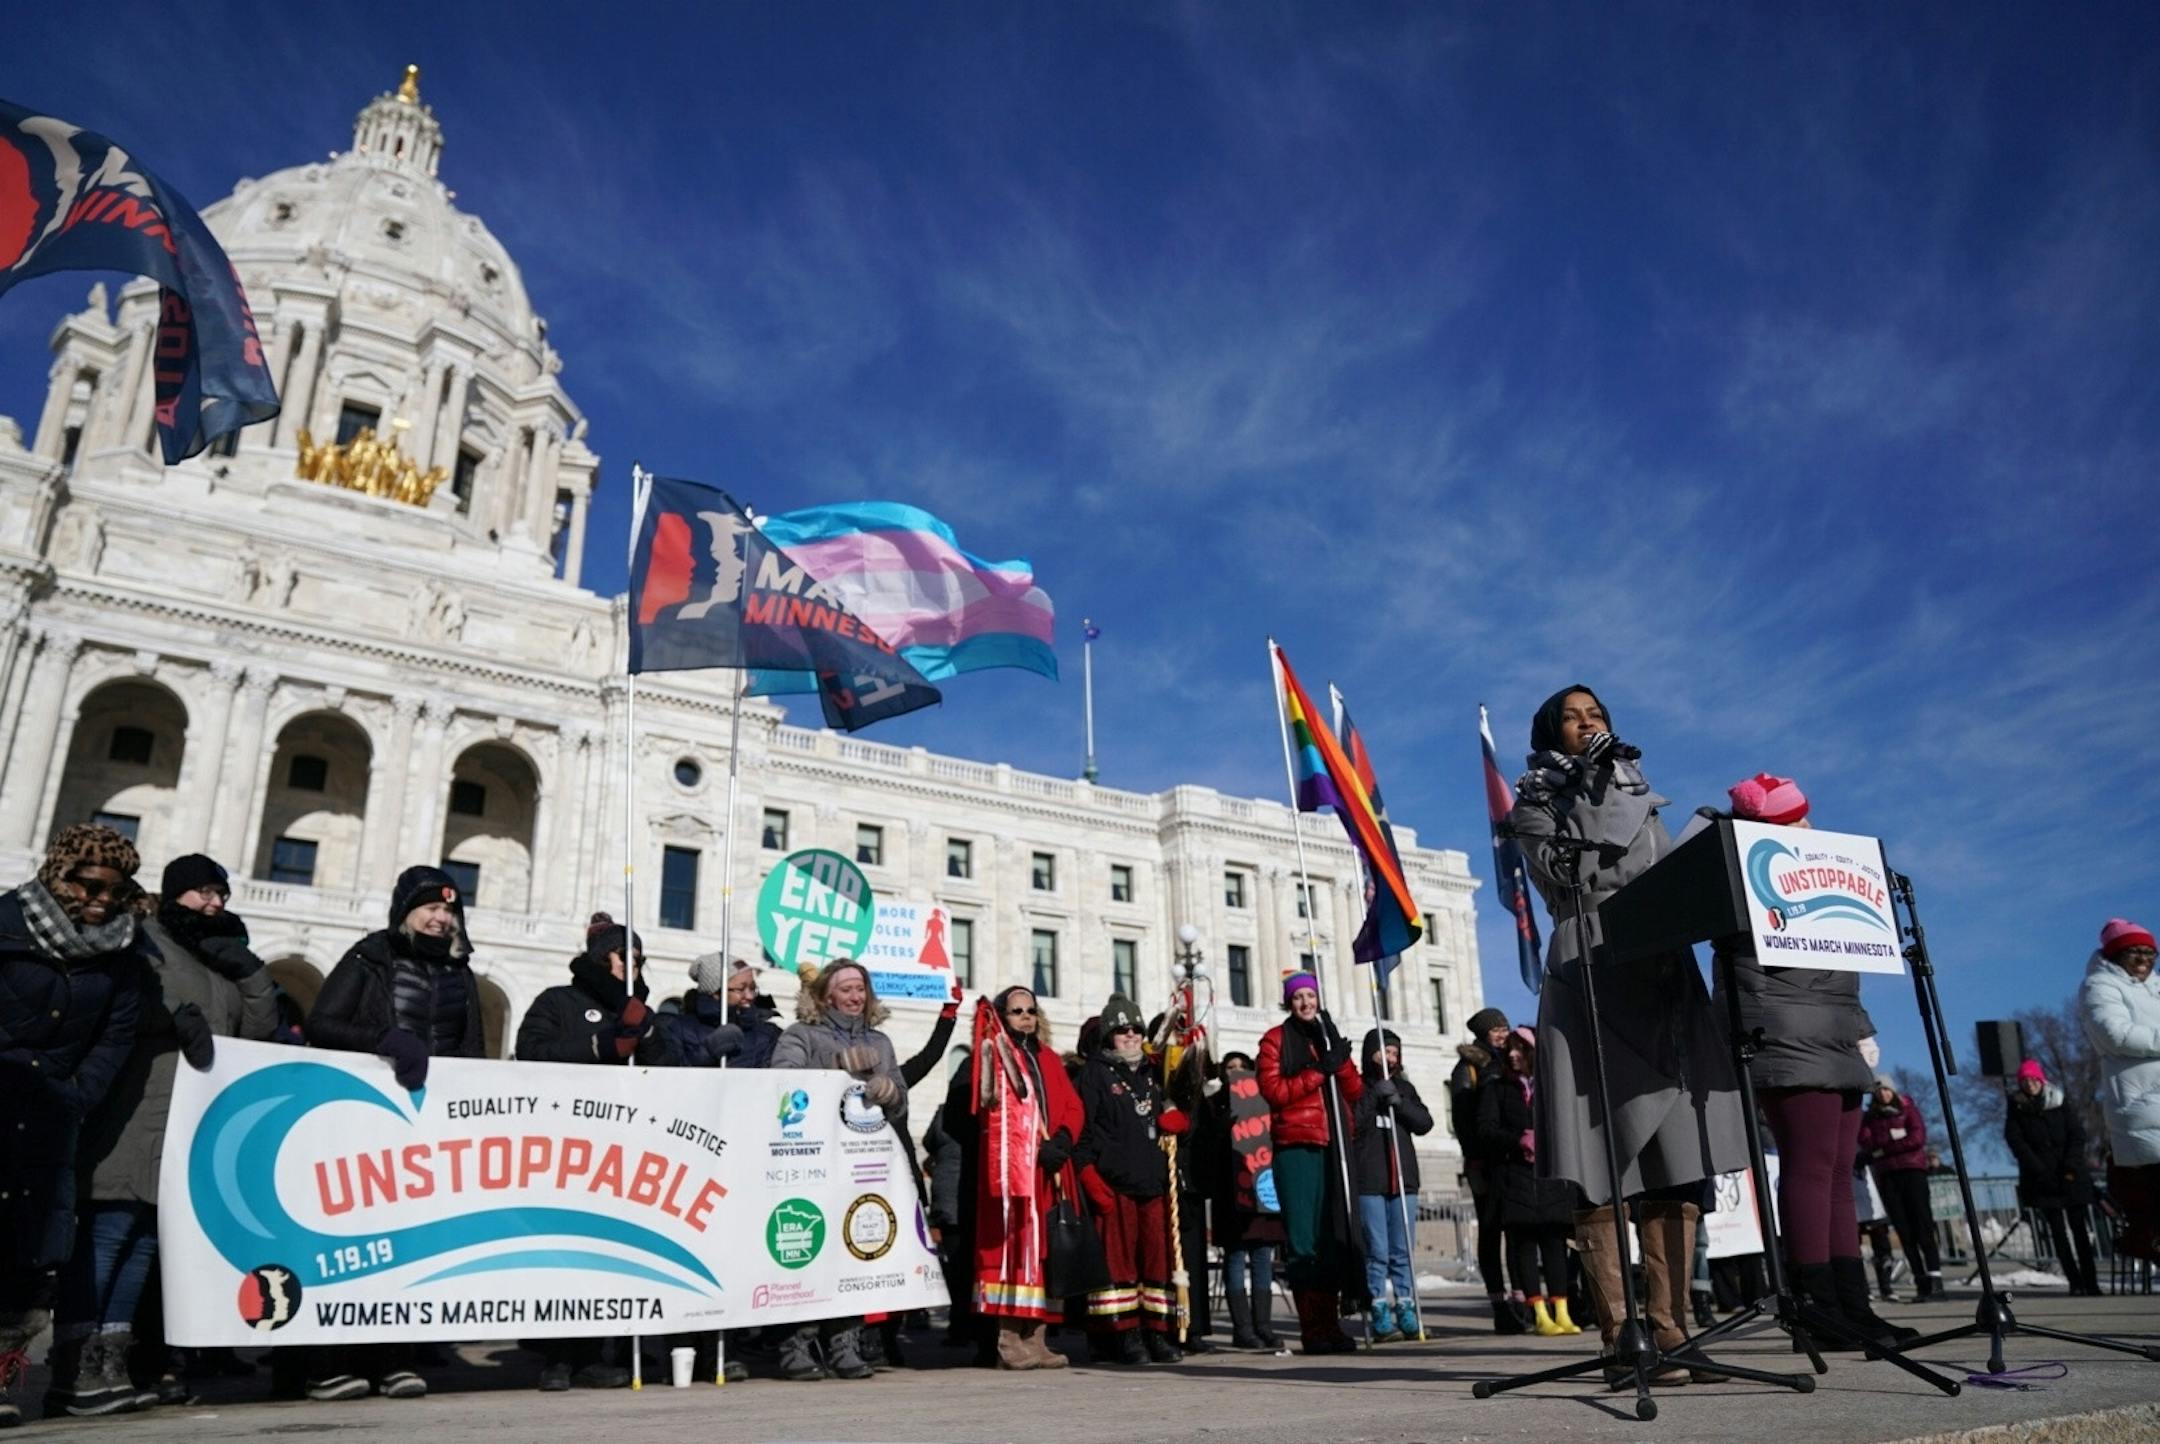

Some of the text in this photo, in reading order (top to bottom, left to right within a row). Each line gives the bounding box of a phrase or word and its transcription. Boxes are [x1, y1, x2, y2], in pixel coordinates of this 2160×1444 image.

[780, 853, 863, 924] ERA
[1778, 867, 1886, 909] UNSTOPPABLE
[879, 907, 916, 920] MORE
[875, 924, 912, 937] OLEN
[867, 944, 915, 958] ISTERS
[1763, 935, 1896, 958] WOMEN'S MARCH MINNESOTA
[1230, 1077, 1260, 1099] YO
[447, 1096, 539, 1119] EQUALITY
[572, 1098, 638, 1124] EQUITY
[666, 1117, 728, 1157] JUSTICE
[771, 1147, 821, 1156] MOVEMENT
[315, 1135, 728, 1233] UNSTOPPABLE
[808, 1168, 827, 1179] MN
[783, 1222, 804, 1232] ERA
[316, 1238, 395, 1279] 1.19.19
[838, 1278, 906, 1293] CONSORTIUM
[316, 1297, 664, 1327] WOMEN'S MARCH MINNESOTA
